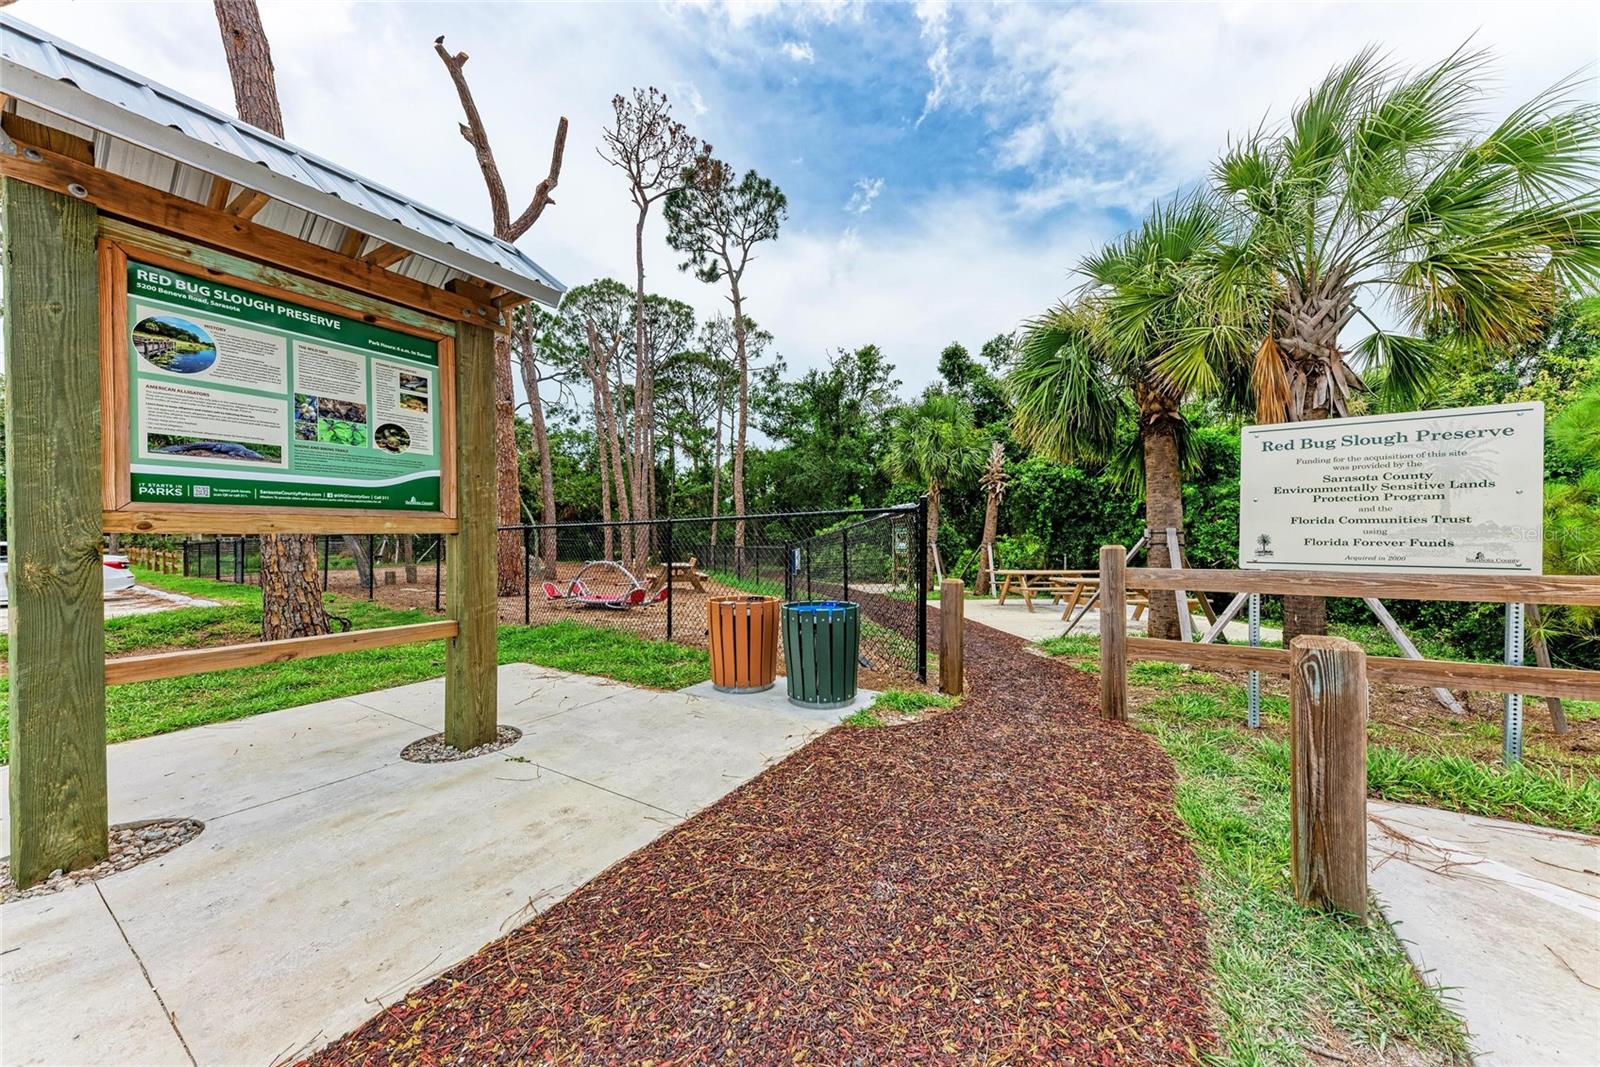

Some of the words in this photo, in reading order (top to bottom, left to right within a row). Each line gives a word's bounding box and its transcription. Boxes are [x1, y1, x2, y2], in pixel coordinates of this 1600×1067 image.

[136, 282, 156, 292] 5200
[158, 288, 187, 299] Beneva
[188, 295, 209, 305] Road,
[210, 300, 240, 312] Sarasota
[137, 269, 171, 286] RED
[176, 280, 210, 297] BUG
[214, 289, 274, 313] SLOUGH
[277, 306, 341, 330] PRESERVE
[145, 384, 176, 394] AMERICAN
[176, 387, 210, 398] ALLIGATORS
[1262, 439, 1295, 452] Red
[1300, 438, 1336, 450] Bug
[1341, 431, 1408, 447] Slough
[1416, 426, 1515, 442] Preserve
[1296, 457, 1331, 465] Funding
[1347, 455, 1361, 463] the
[1363, 453, 1414, 463] acquisition
[1417, 451, 1426, 459] of
[1428, 450, 1447, 458] this
[1352, 462, 1390, 472] provided
[1393, 461, 1405, 469] by
[1407, 460, 1423, 468] the
[1322, 474, 1378, 483] Sarasota
[1383, 472, 1433, 482] County
[139, 486, 183, 497] PARKS
[1273, 483, 1378, 495] Environmentally
[1381, 481, 1445, 491] Sensitive
[1450, 479, 1496, 489] Lands
[1313, 493, 1379, 503] Protection
[1384, 493, 1445, 502] Program
[1290, 516, 1335, 525] Florida
[1338, 515, 1428, 525] Communities
[1432, 515, 1472, 524] Trust
[1304, 538, 1349, 547] Florida
[1353, 538, 1406, 547] Forever
[1409, 538, 1455, 548] Funds
[1495, 557, 1520, 565] County
